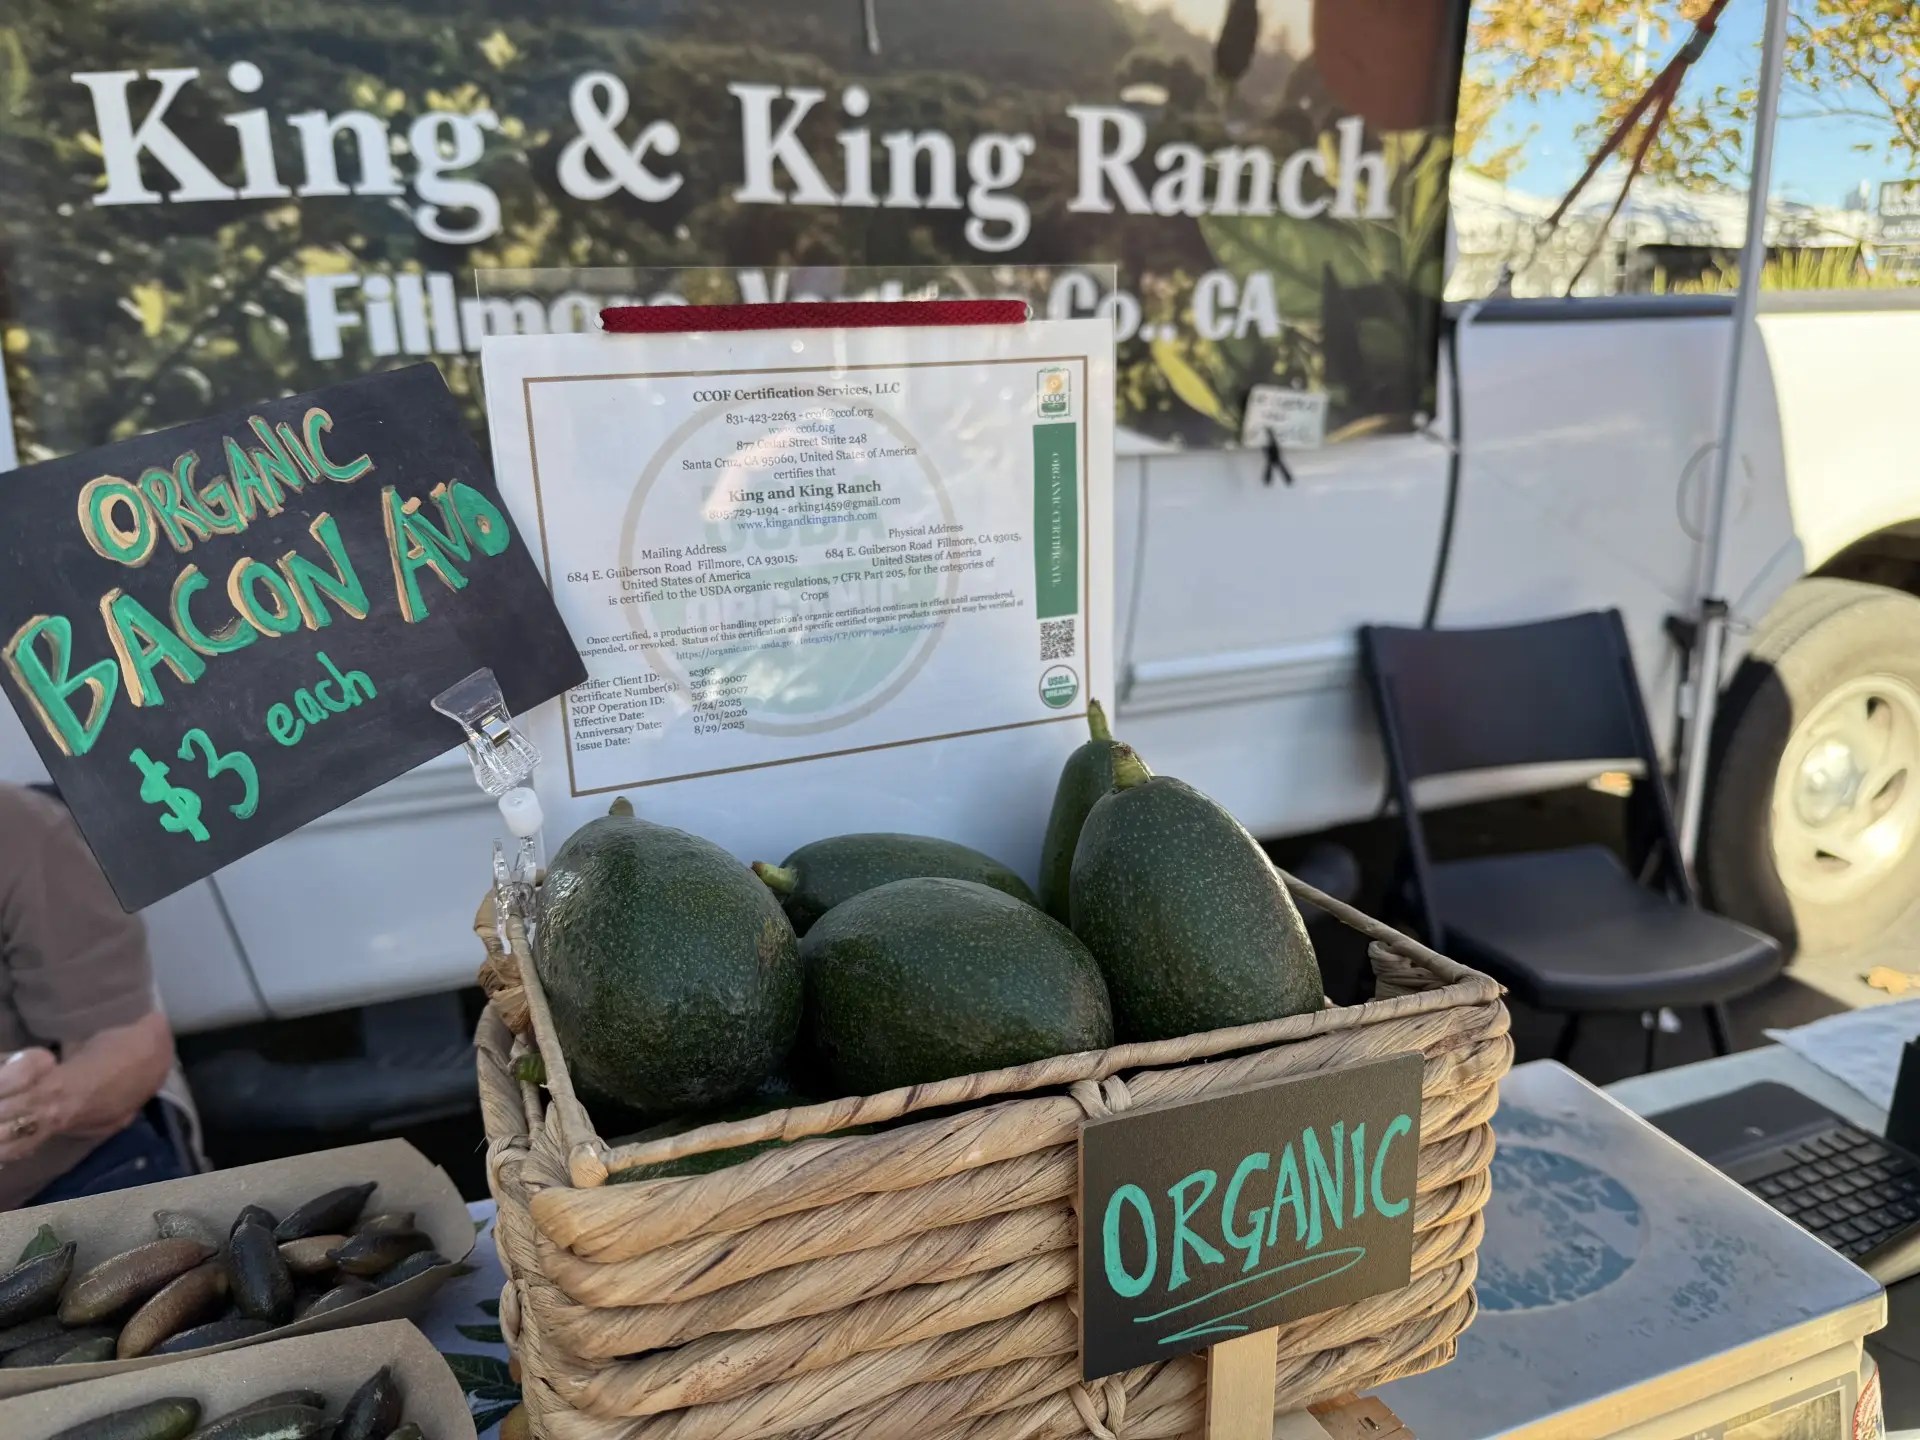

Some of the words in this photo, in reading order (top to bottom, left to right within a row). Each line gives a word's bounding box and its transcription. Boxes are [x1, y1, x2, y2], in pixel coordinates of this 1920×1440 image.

[71, 60, 501, 244] King
[557, 70, 684, 202] &
[728, 82, 1035, 251] King
[1067, 104, 1394, 219] Ranch
[305, 271, 688, 360] Fillmo
[1193, 269, 1280, 341] CA
[693, 389, 731, 402] CCOF
[735, 386, 814, 400] Certification
[817, 384, 872, 397] Services,
[876, 382, 900, 394] LLC
[726, 410, 796, 425] 831-423-2263
[806, 406, 874, 419] ccof@ccof.org
[768, 422, 835, 434] wwwccof.org
[737, 441, 754, 452] 877
[789, 436, 818, 448] Street
[821, 435, 846, 445] Suite
[849, 433, 867, 445] 248
[683, 460, 711, 470] Santa
[715, 458, 741, 468] Cruz,
[744, 456, 759, 466] CA
[761, 455, 797, 467] 95060,
[800, 451, 833, 462] United
[836, 451, 865, 460] States
[868, 448, 877, 458] of
[880, 446, 917, 457] America
[774, 468, 813, 480] certifies
[816, 467, 836, 476] that
[79, 407, 375, 567] ORGANIC
[728, 489, 764, 503] King
[767, 486, 794, 499] and
[799, 484, 833, 498] King
[837, 480, 881, 494] Ranch
[709, 507, 779, 520] 805-729-1194
[788, 497, 901, 513] arking1459@gmail.com
[737, 511, 877, 530] www.kingandkingranch.com
[889, 526, 926, 539] Physical
[928, 524, 964, 535] Address
[642, 547, 682, 560] Mailing
[685, 544, 727, 556] Address
[825, 549, 844, 559] 684
[847, 548, 856, 557] E.
[858, 544, 906, 556] Guiberson
[909, 541, 932, 551] Road
[937, 537, 977, 548] Fillmore,
[978, 535, 991, 544] CA
[872, 555, 903, 567] United
[905, 553, 932, 564] States
[934, 551, 944, 560] of
[946, 548, 982, 559] America
[567, 572, 589, 583] 684
[592, 571, 603, 580] E.
[606, 566, 661, 579] Guiberson
[664, 561, 692, 573] Road
[698, 558, 744, 570] Fillmore,
[747, 556, 762, 566] CA
[608, 596, 617, 606] is
[620, 590, 664, 604] certified
[666, 591, 677, 600] to
[680, 588, 697, 599] the
[700, 585, 732, 597] USDA
[734, 581, 772, 595] organic
[774, 576, 831, 590] regulations,
[833, 576, 838, 584] 7
[841, 573, 861, 583] CFR
[864, 571, 883, 581] Part
[886, 569, 906, 579] 205,
[908, 566, 922, 576] for
[924, 565, 938, 574] the
[940, 561, 984, 573] categories
[986, 557, 995, 568] of
[622, 579, 658, 590] United
[660, 576, 693, 587] States
[695, 573, 706, 584] of
[708, 570, 751, 582] America
[800, 591, 828, 602] Crops
[2, 512, 370, 755] BACON
[382, 478, 510, 623] AVO
[587, 636, 610, 645] Once
[612, 630, 651, 642] certified,
[660, 626, 708, 638] production
[720, 619, 757, 631] handling
[759, 613, 803, 627] operation's
[804, 611, 834, 621] organic
[835, 606, 881, 618] certification
[929, 597, 950, 607] effect
[951, 595, 968, 604] until
[640, 638, 678, 649] revoked.
[682, 637, 708, 646] Status
[710, 634, 720, 642] of
[720, 632, 736, 641] this
[738, 627, 786, 639] certification
[788, 624, 803, 633] and
[804, 621, 834, 633] specific
[835, 616, 867, 627] certified
[868, 613, 896, 625] organic
[898, 610, 930, 621] products
[931, 606, 960, 616] covered
[962, 605, 977, 613] may
[989, 599, 1015, 609] verified
[570, 691, 622, 703] Certificate
[624, 682, 680, 697] Number(s):
[690, 674, 747, 690] 5561009007
[613, 675, 643, 687] Client
[644, 673, 660, 682] ID:
[572, 705, 596, 716] NOP
[598, 699, 648, 713] Operation
[650, 696, 665, 706] ID:
[574, 715, 617, 727] Effective
[619, 711, 645, 722] Date:
[692, 698, 742, 713] 7/24/2025
[575, 725, 634, 740] Anniversary
[636, 721, 662, 731] Date:
[693, 707, 748, 723] 01/01/2026
[130, 728, 259, 842] $3
[267, 652, 377, 746] each
[576, 740, 602, 752] Issue
[604, 737, 631, 747] Date:
[694, 720, 745, 735] 8/29/2025
[1103, 1114, 1412, 1297] ORGANIC
